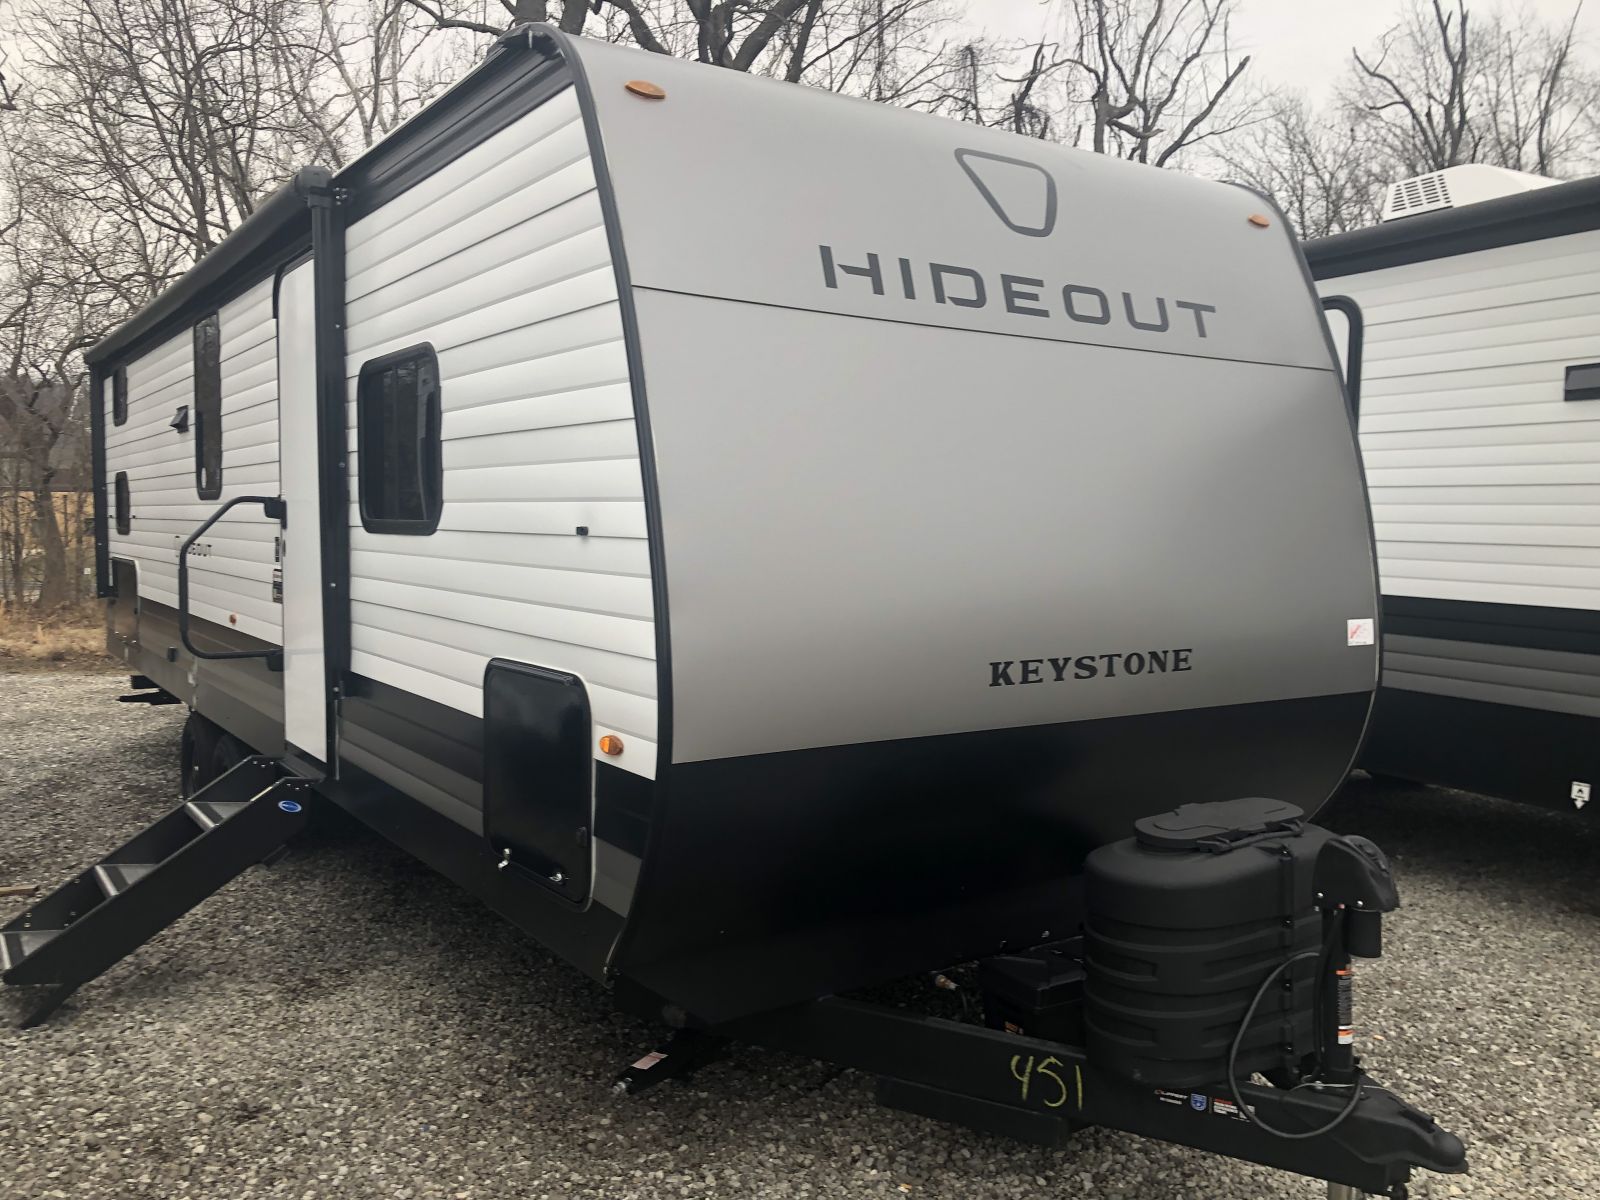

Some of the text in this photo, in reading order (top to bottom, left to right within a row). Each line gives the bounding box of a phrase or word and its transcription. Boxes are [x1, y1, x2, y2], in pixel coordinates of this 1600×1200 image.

[819, 244, 1217, 338] HIDEOUT
[989, 648, 1193, 687] KEYSTONE
[1010, 1055, 1083, 1111] 451
